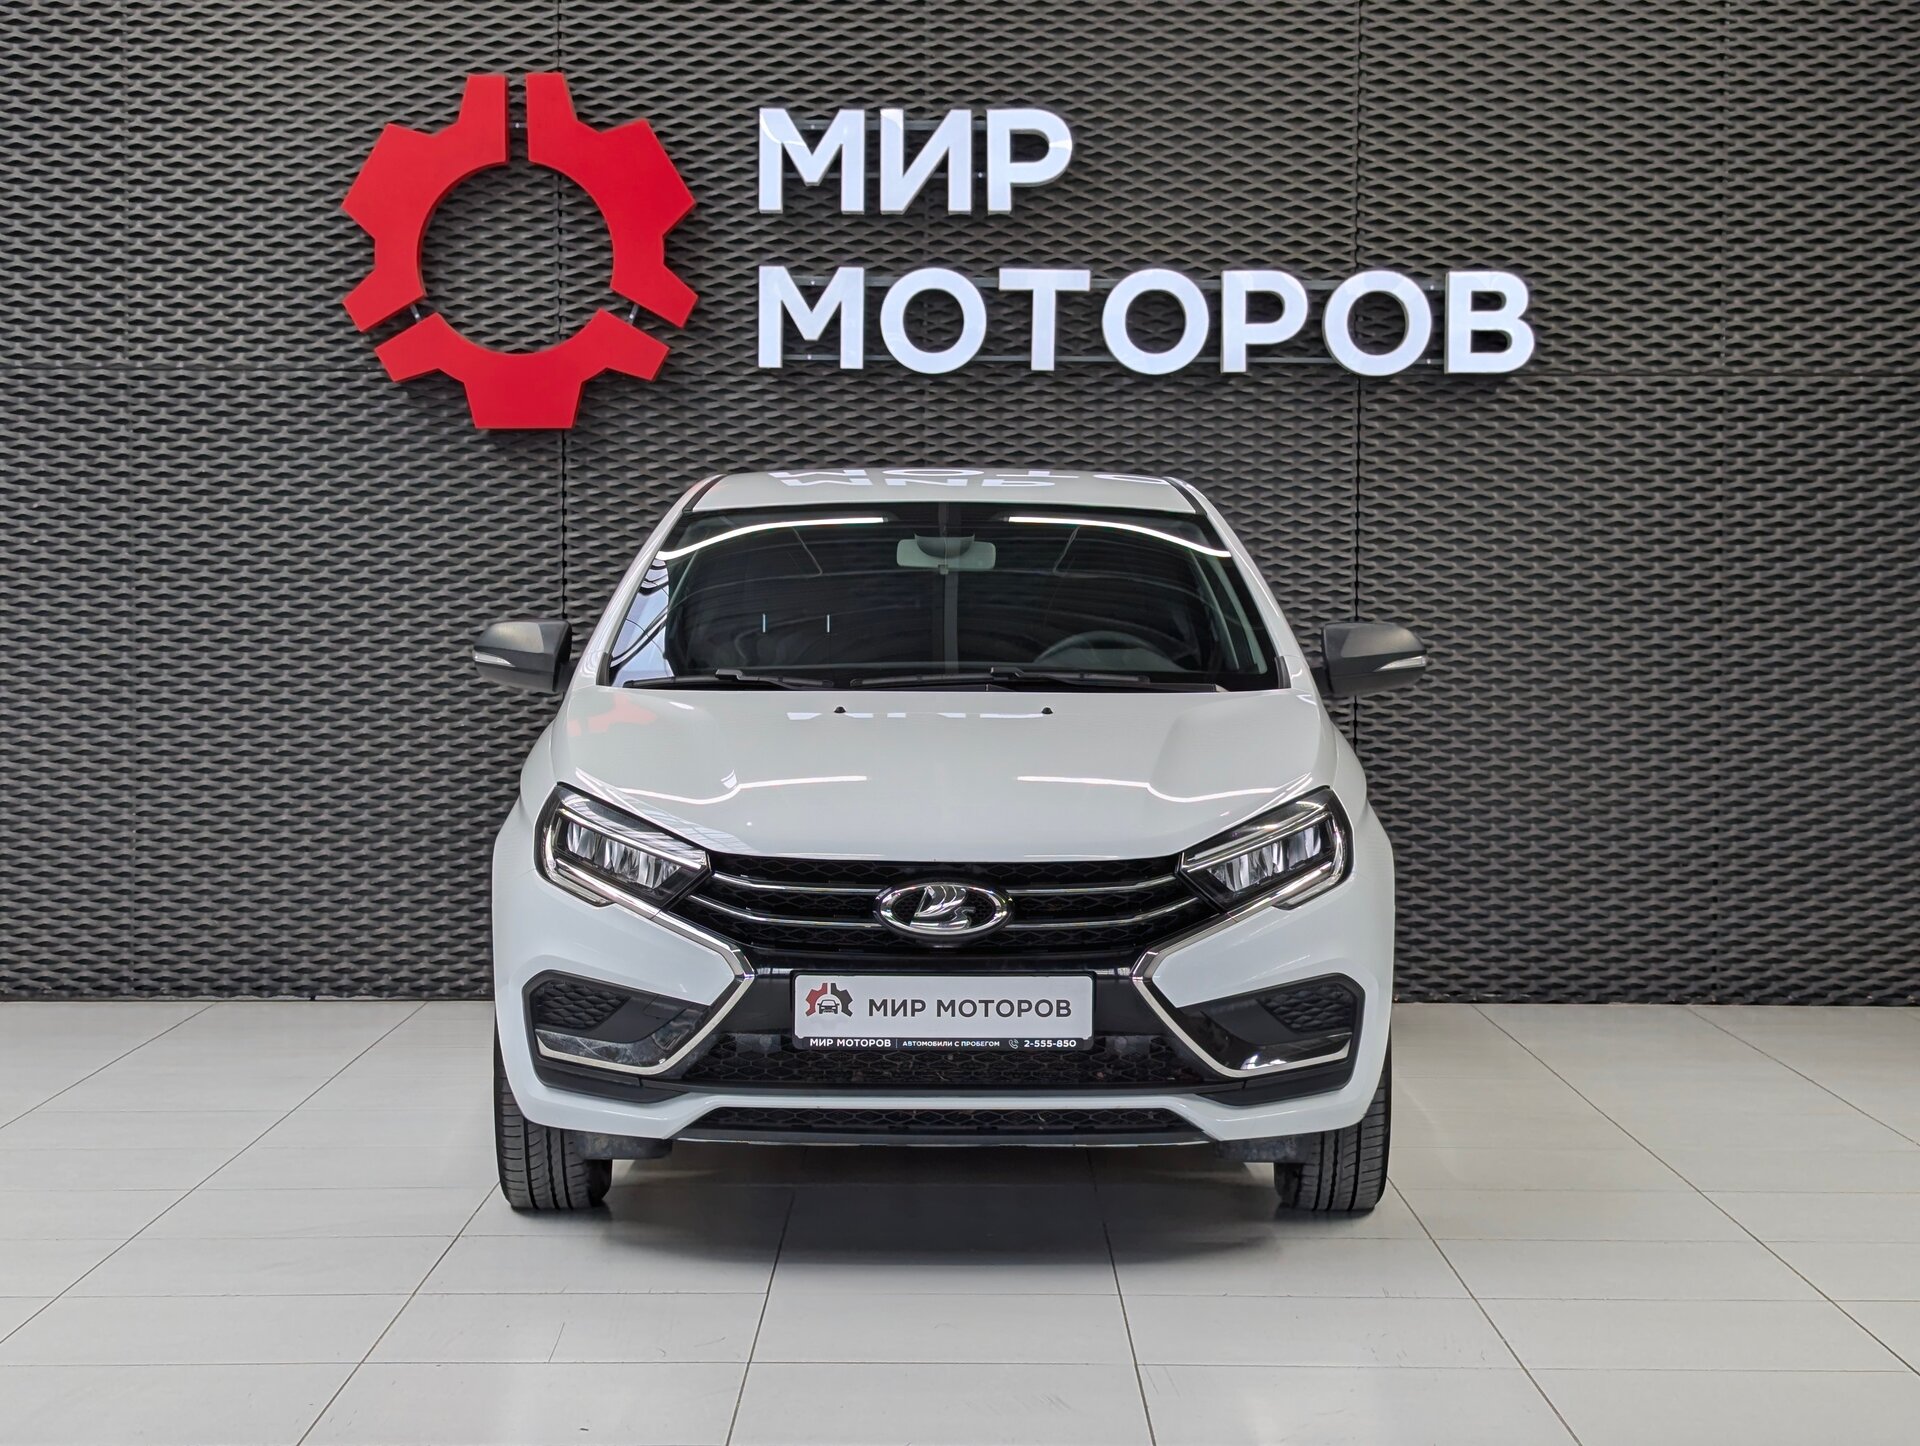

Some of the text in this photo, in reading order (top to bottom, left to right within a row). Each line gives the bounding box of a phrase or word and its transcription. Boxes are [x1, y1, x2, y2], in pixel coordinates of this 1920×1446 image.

[758, 107, 1073, 215] МИР
[758, 265, 1536, 376] МОТОРОВ
[868, 998, 1073, 1018] МИР МОТОРОВ
[809, 1038, 892, 1048] МИР МОТОРОВ
[1023, 1039, 1077, 1048] 2-555-850
